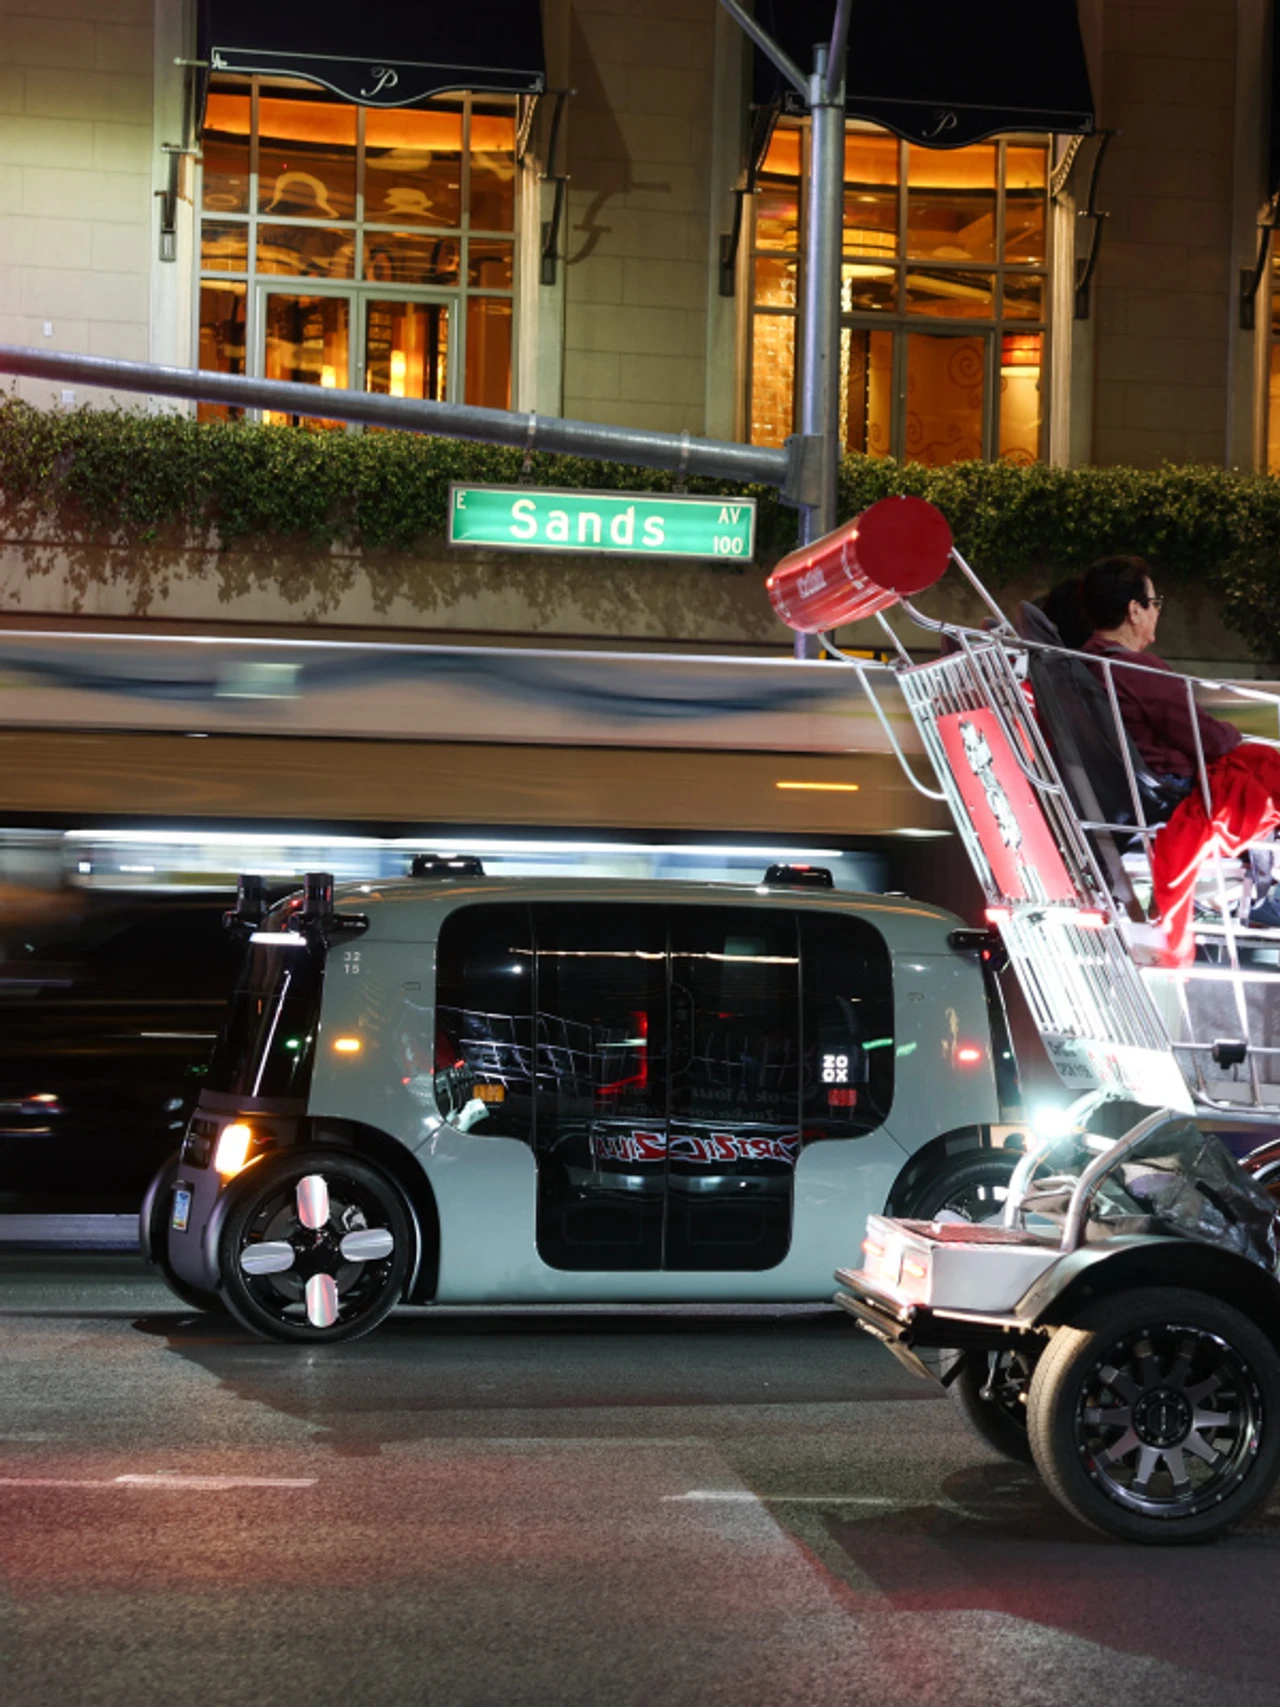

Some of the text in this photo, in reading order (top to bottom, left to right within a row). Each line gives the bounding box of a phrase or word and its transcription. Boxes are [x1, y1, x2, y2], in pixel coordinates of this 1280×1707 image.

[361, 65, 399, 97] P
[456, 491, 742, 547] E Sands AV
[713, 535, 743, 555] 100
